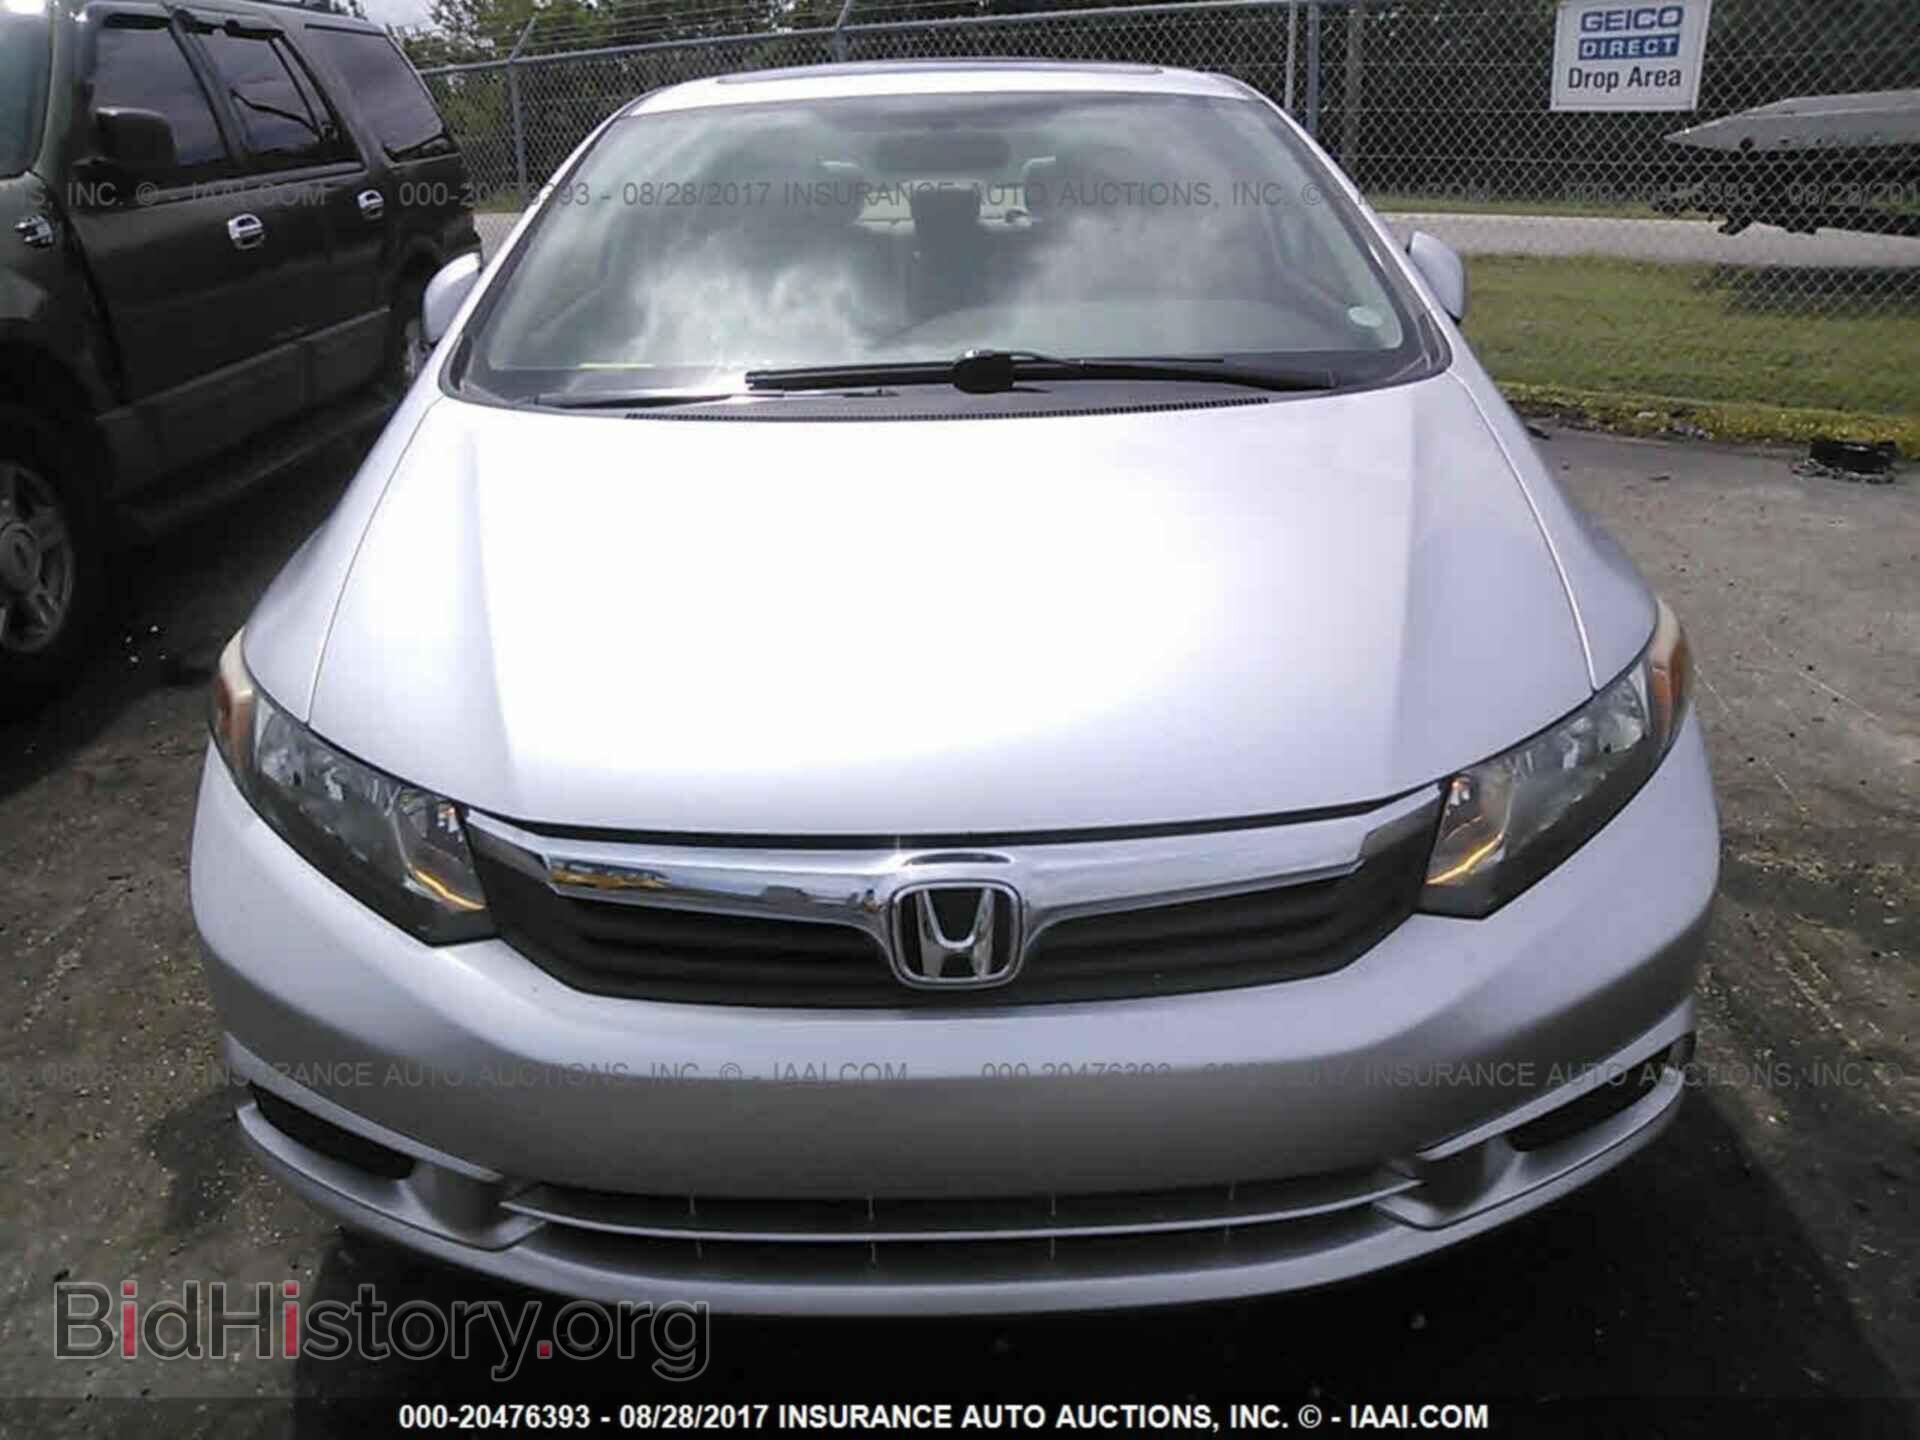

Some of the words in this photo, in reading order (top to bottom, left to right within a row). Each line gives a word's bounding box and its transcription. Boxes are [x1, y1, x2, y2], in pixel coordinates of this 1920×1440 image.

[1581, 6, 1684, 32] GEICO
[1581, 38, 1676, 57] DIRECT
[1568, 67, 1619, 93] Drop
[1627, 66, 1682, 87] Area
